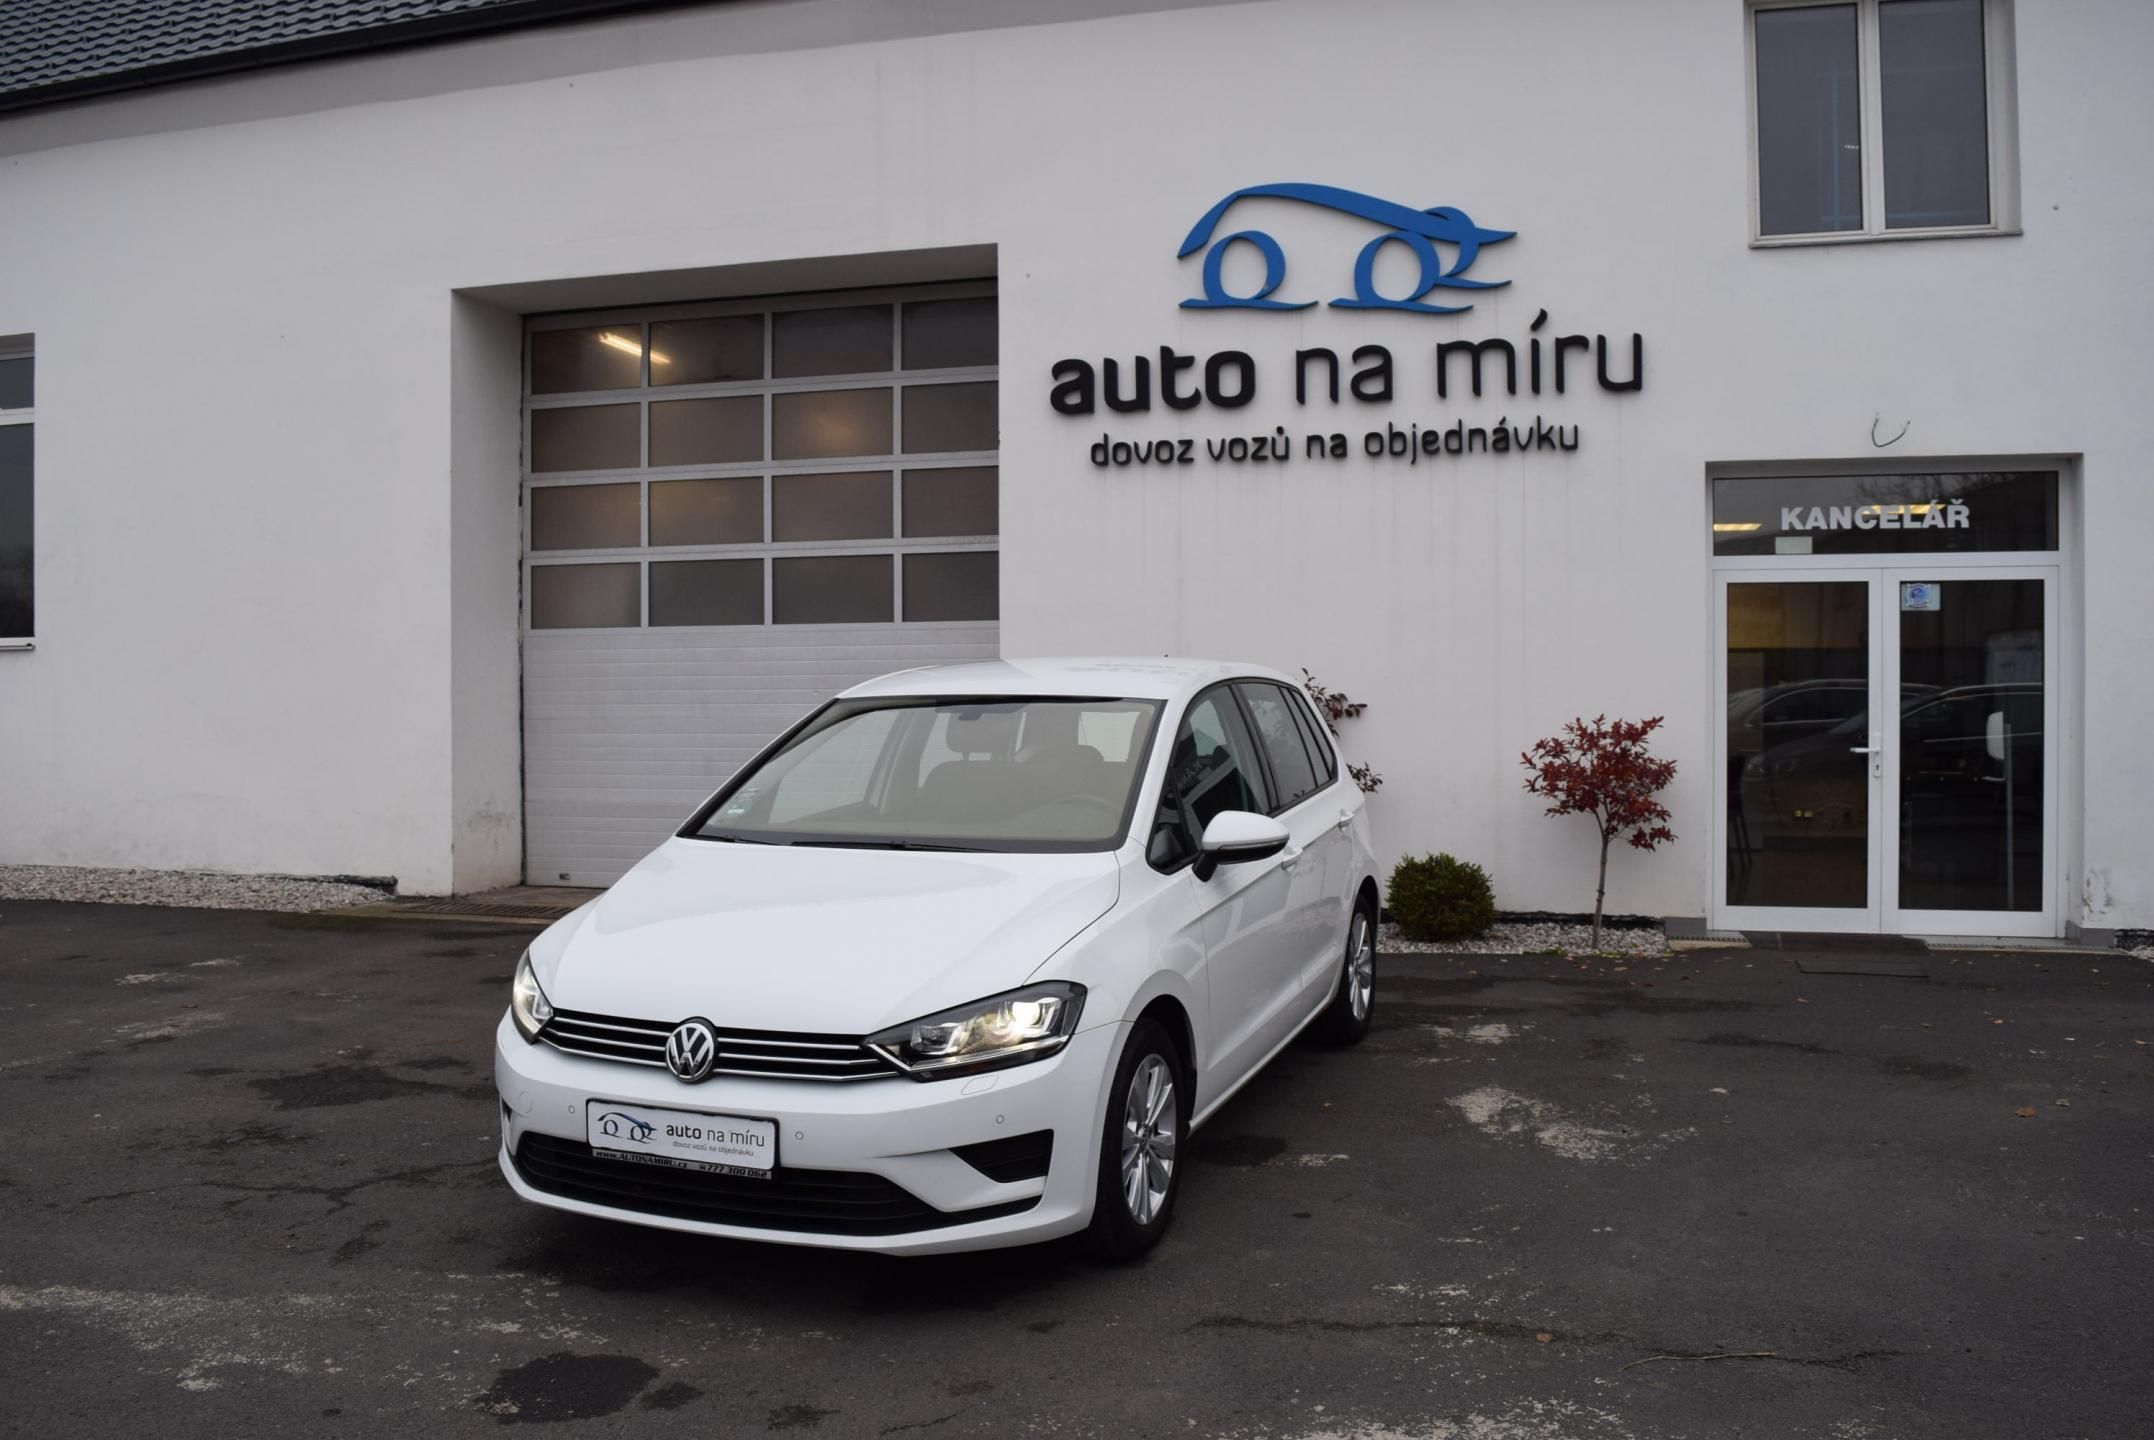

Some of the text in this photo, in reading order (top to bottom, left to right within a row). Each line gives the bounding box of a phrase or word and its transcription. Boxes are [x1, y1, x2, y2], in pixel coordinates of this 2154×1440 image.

[1050, 309, 1643, 415] auto na míru
[1091, 415, 1579, 466] dovoz vozů na objednávku
[1781, 499, 1970, 530] KANCELÁŘ
[666, 1125, 765, 1147] auto na míru
